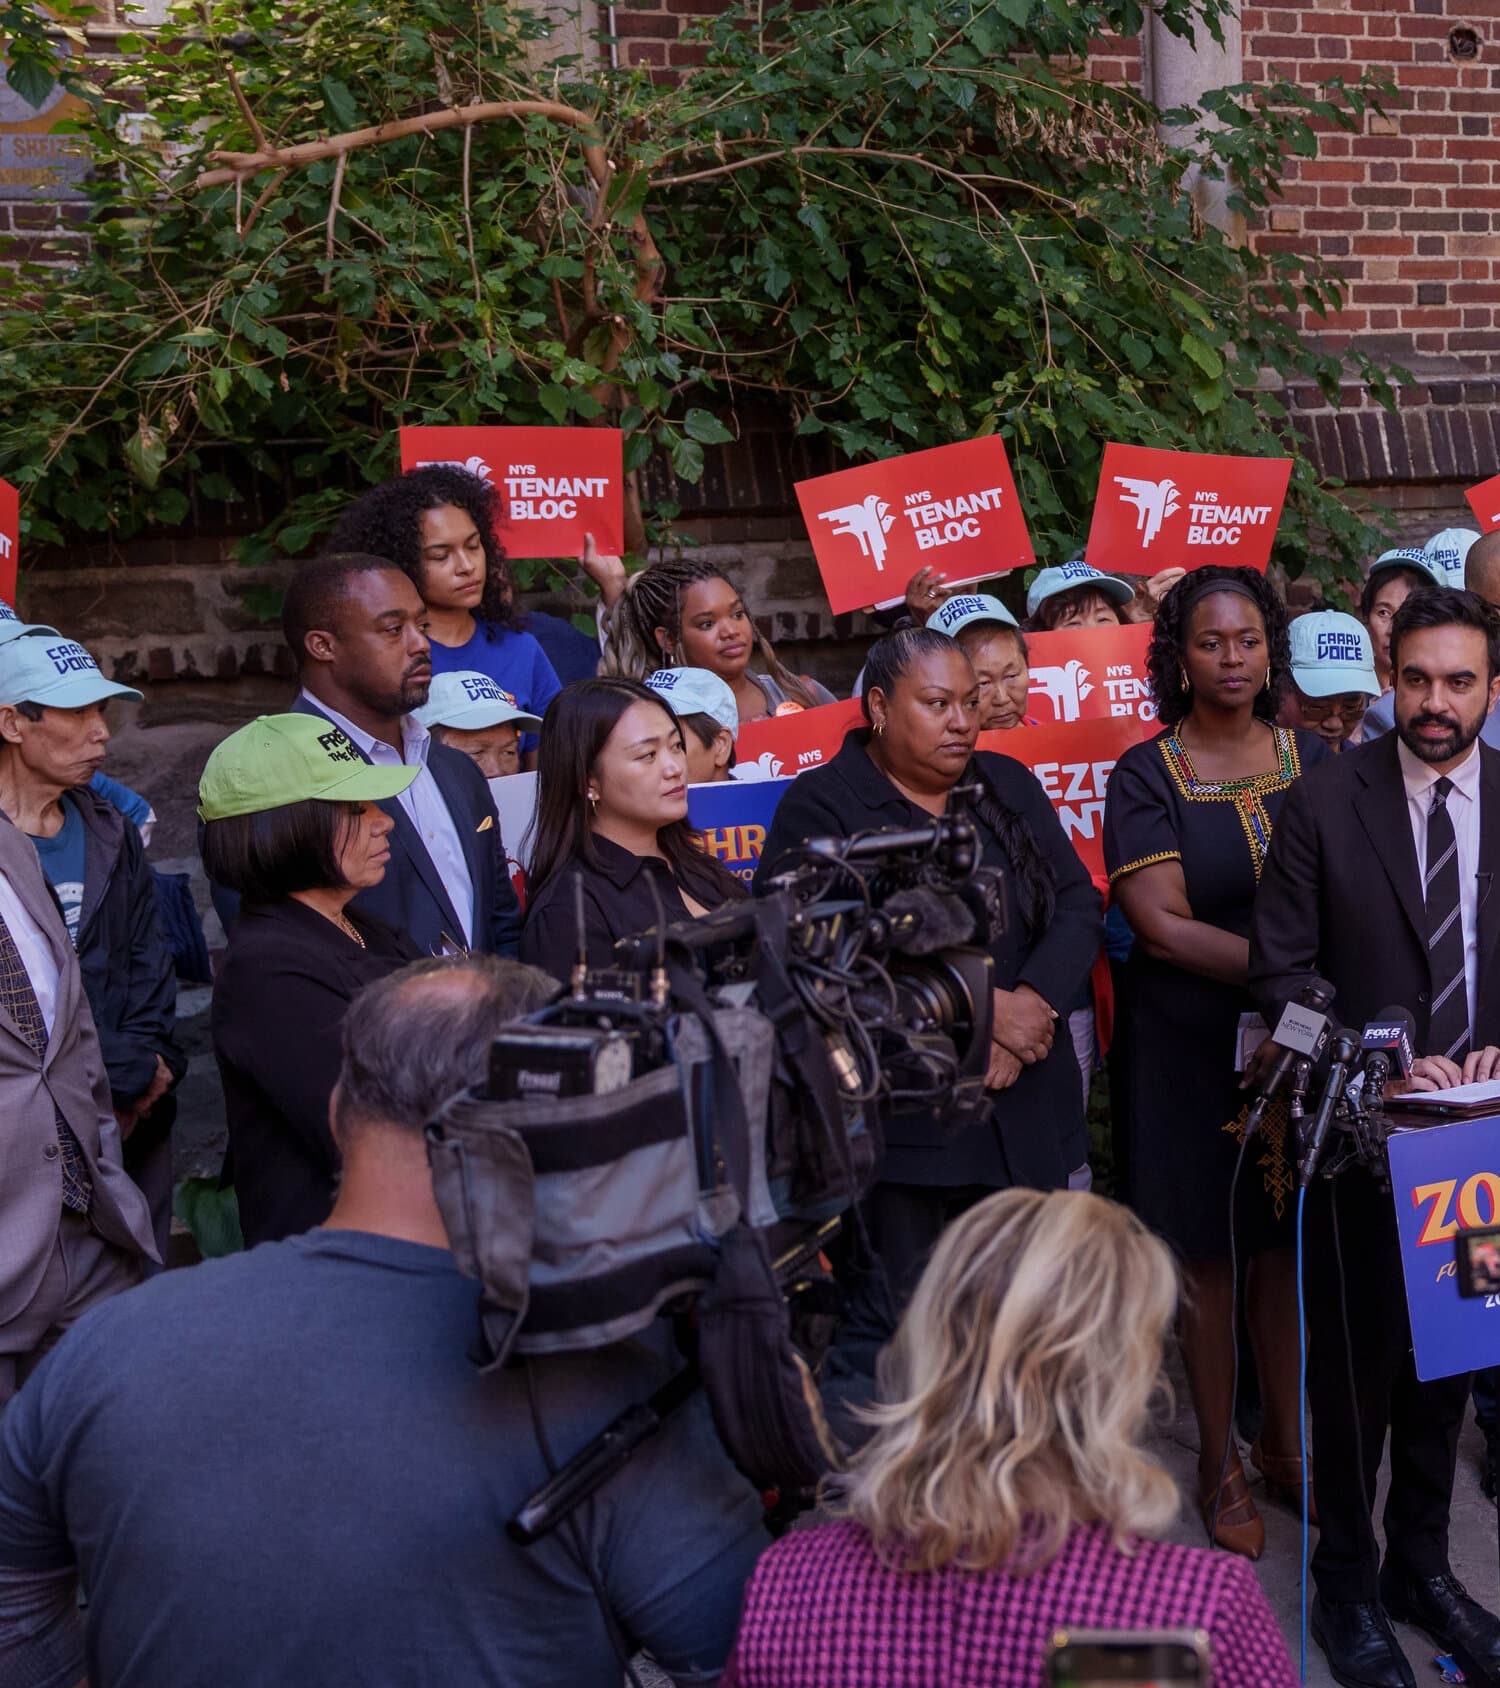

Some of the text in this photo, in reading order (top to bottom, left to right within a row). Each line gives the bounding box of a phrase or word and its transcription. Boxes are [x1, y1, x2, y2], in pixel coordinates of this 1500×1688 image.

[508, 464, 536, 475] NYS
[504, 478, 609, 498] TENANT
[905, 490, 932, 505] NYS
[1195, 491, 1218, 502] NYS
[510, 499, 577, 520] BLOC
[903, 487, 1003, 528] TENANT
[1188, 503, 1272, 525] TENANT
[915, 518, 982, 550] BLOC
[1187, 525, 1241, 545] BLOC
[944, 603, 989, 629] VOICE
[1317, 645, 1363, 661] VOICE
[54, 656, 98, 675] VOIC
[1106, 665, 1133, 677] NYS
[466, 686, 508, 702] VOIC
[1103, 678, 1155, 701] TEN
[1111, 701, 1158, 721] BLO
[798, 750, 823, 766] NYS
[1030, 760, 1118, 801] EZE
[1436, 1260, 1458, 1283] FO
